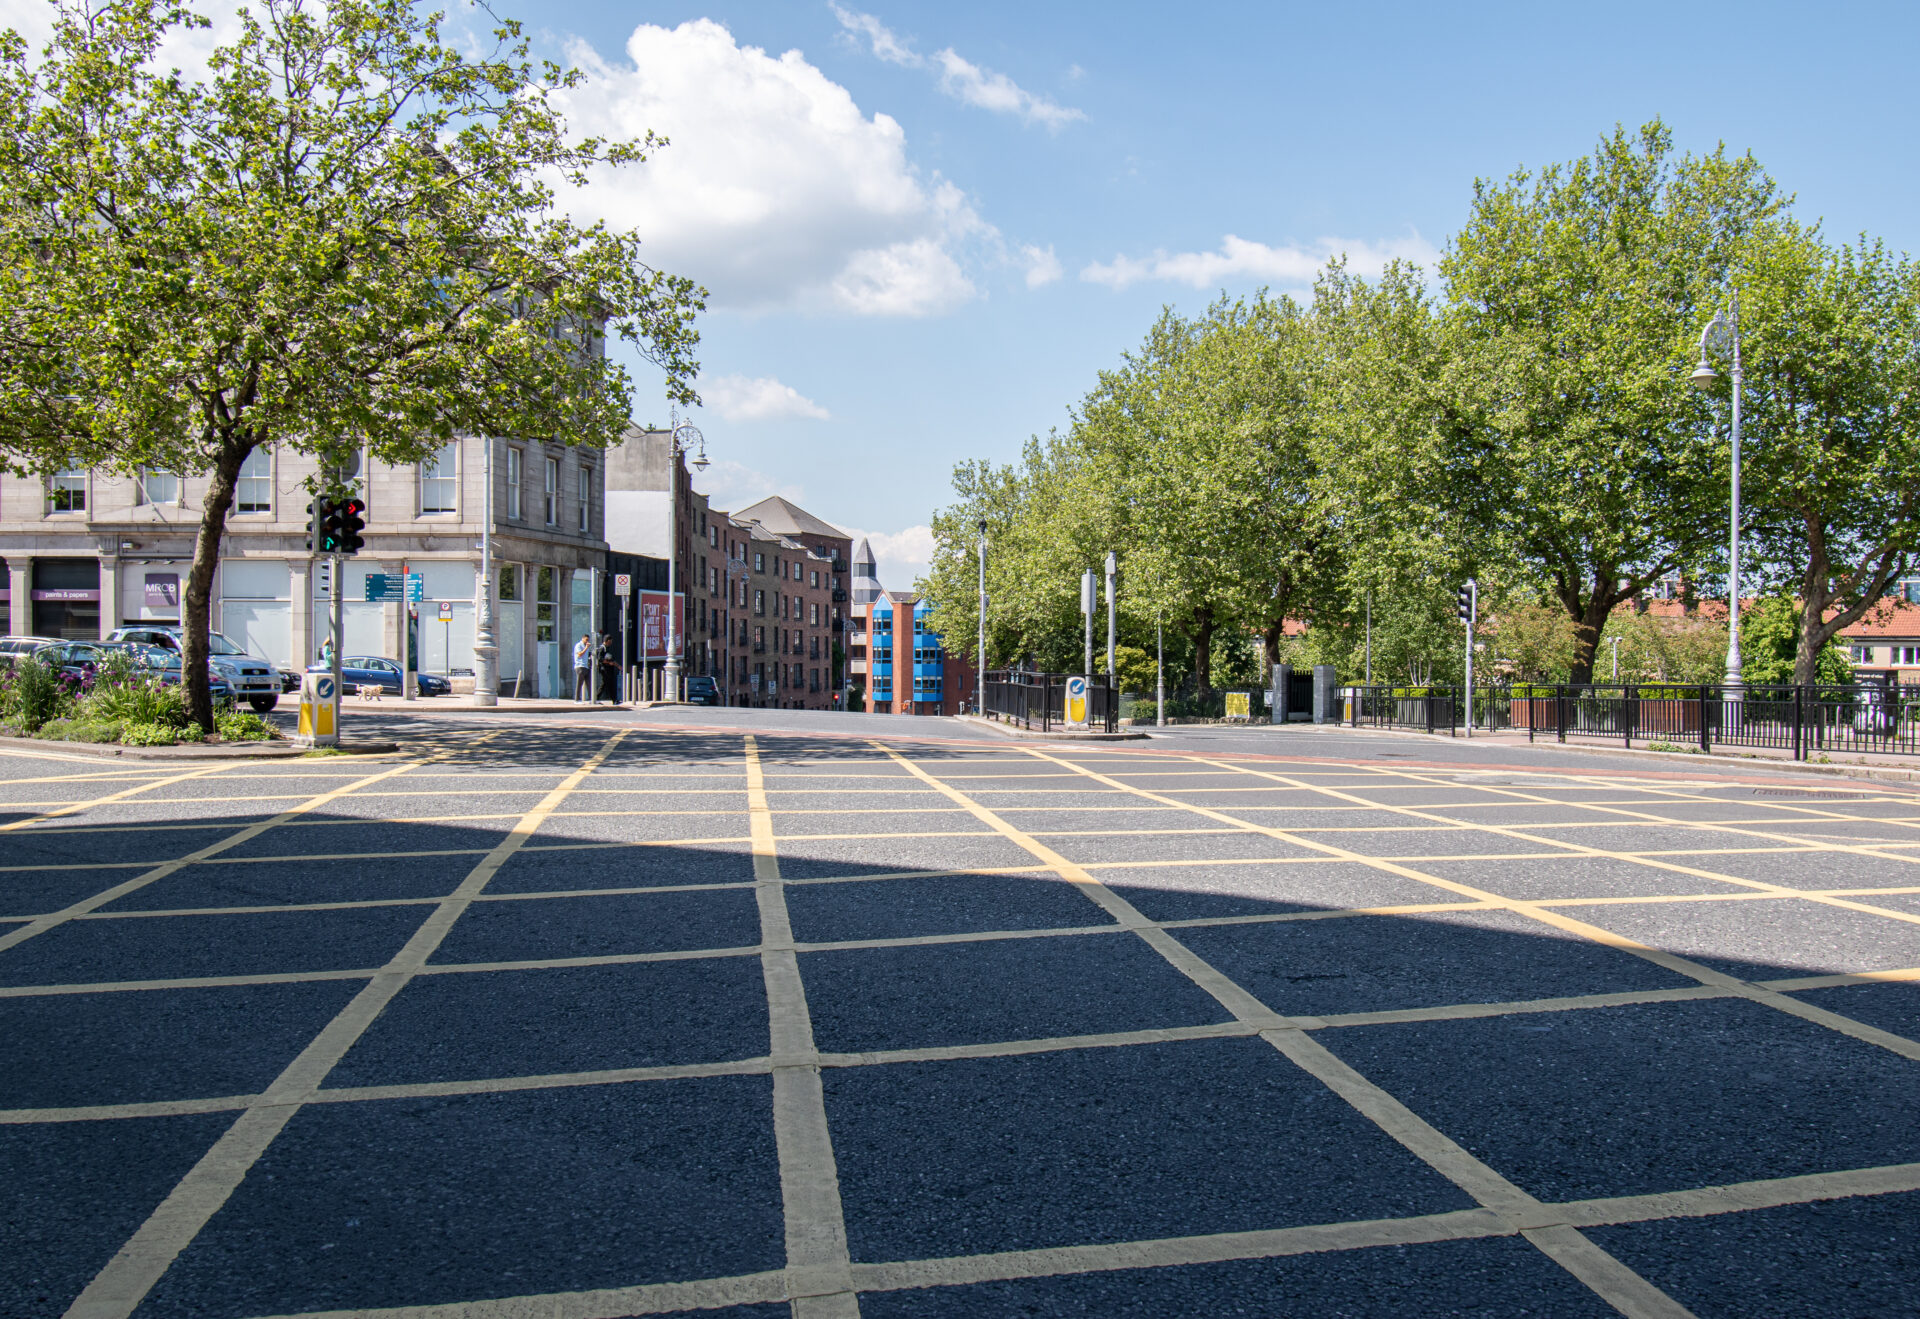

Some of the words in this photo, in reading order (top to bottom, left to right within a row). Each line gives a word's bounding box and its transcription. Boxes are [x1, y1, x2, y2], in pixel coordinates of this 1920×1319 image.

[145, 583, 176, 592] MRCB
[45, 591, 62, 599] paints
[69, 591, 88, 600] papers
